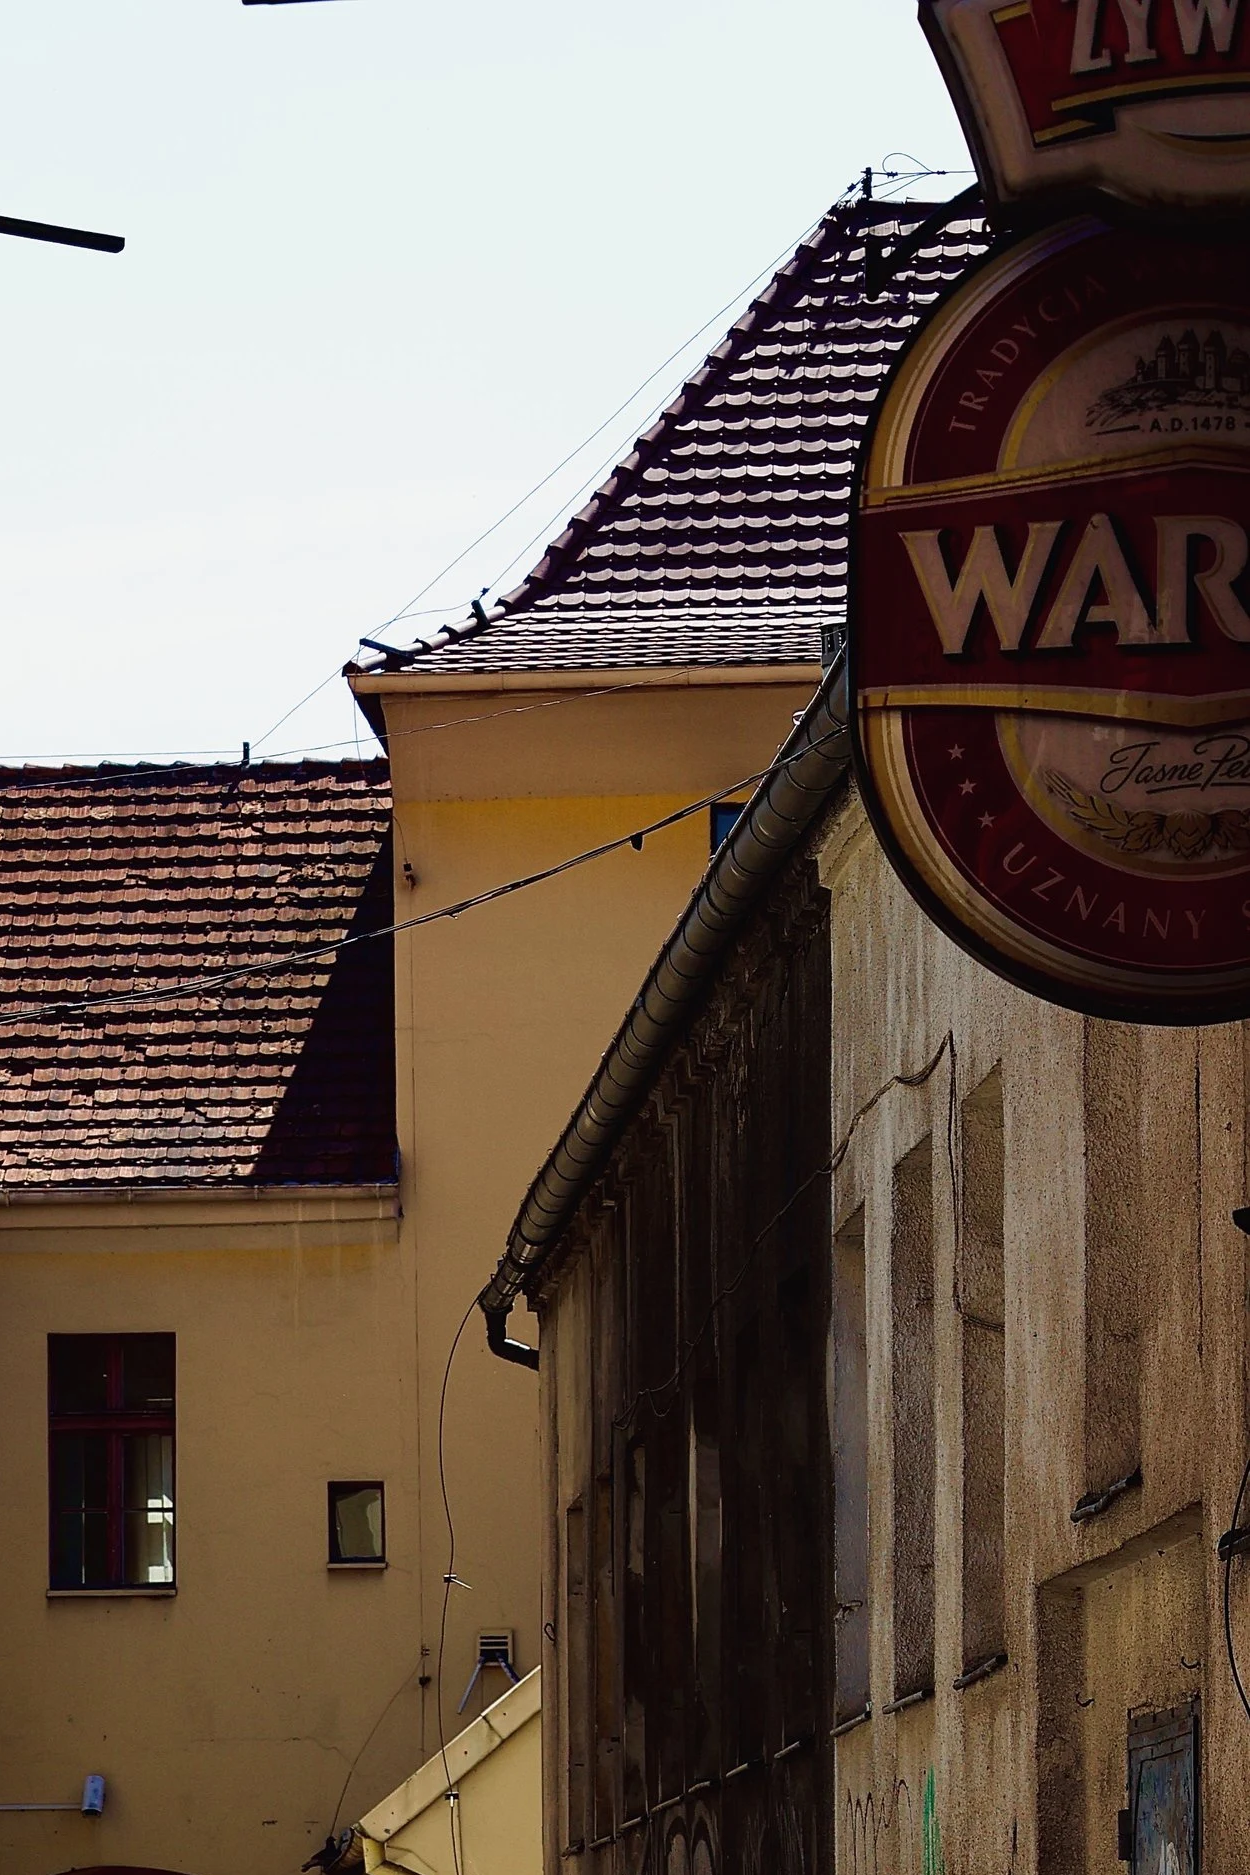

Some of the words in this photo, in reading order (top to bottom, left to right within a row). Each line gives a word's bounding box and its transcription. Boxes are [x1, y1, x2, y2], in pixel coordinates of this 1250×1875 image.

[948, 273, 1106, 433] TRADYCJA
[1149, 416, 1236, 433] A.D.1478
[898, 512, 1250, 654] WAR
[1100, 741, 1205, 794] Jasne
[1002, 841, 1206, 940] UZNANY
